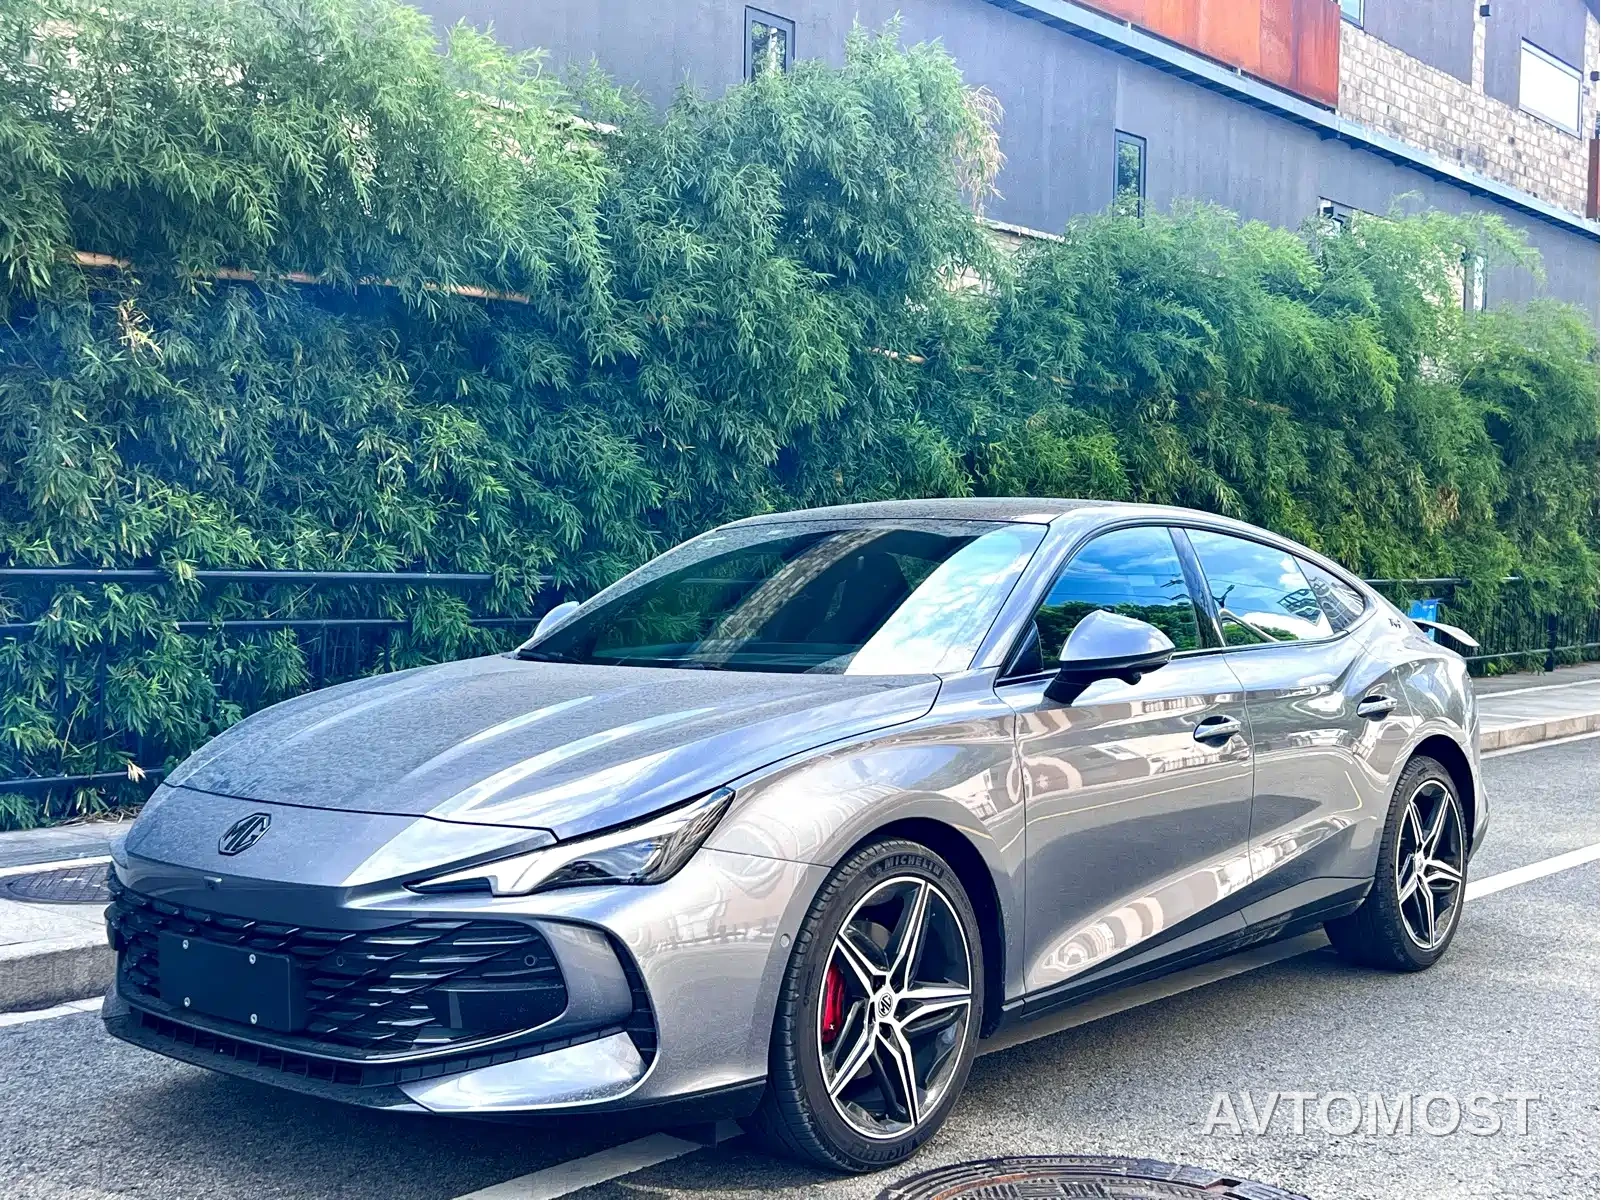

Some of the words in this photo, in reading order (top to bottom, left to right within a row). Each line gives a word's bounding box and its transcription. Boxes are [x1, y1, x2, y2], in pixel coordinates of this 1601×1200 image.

[220, 814, 269, 854] MG
[884, 855, 941, 875] MICHELIN
[879, 994, 892, 1017] MG
